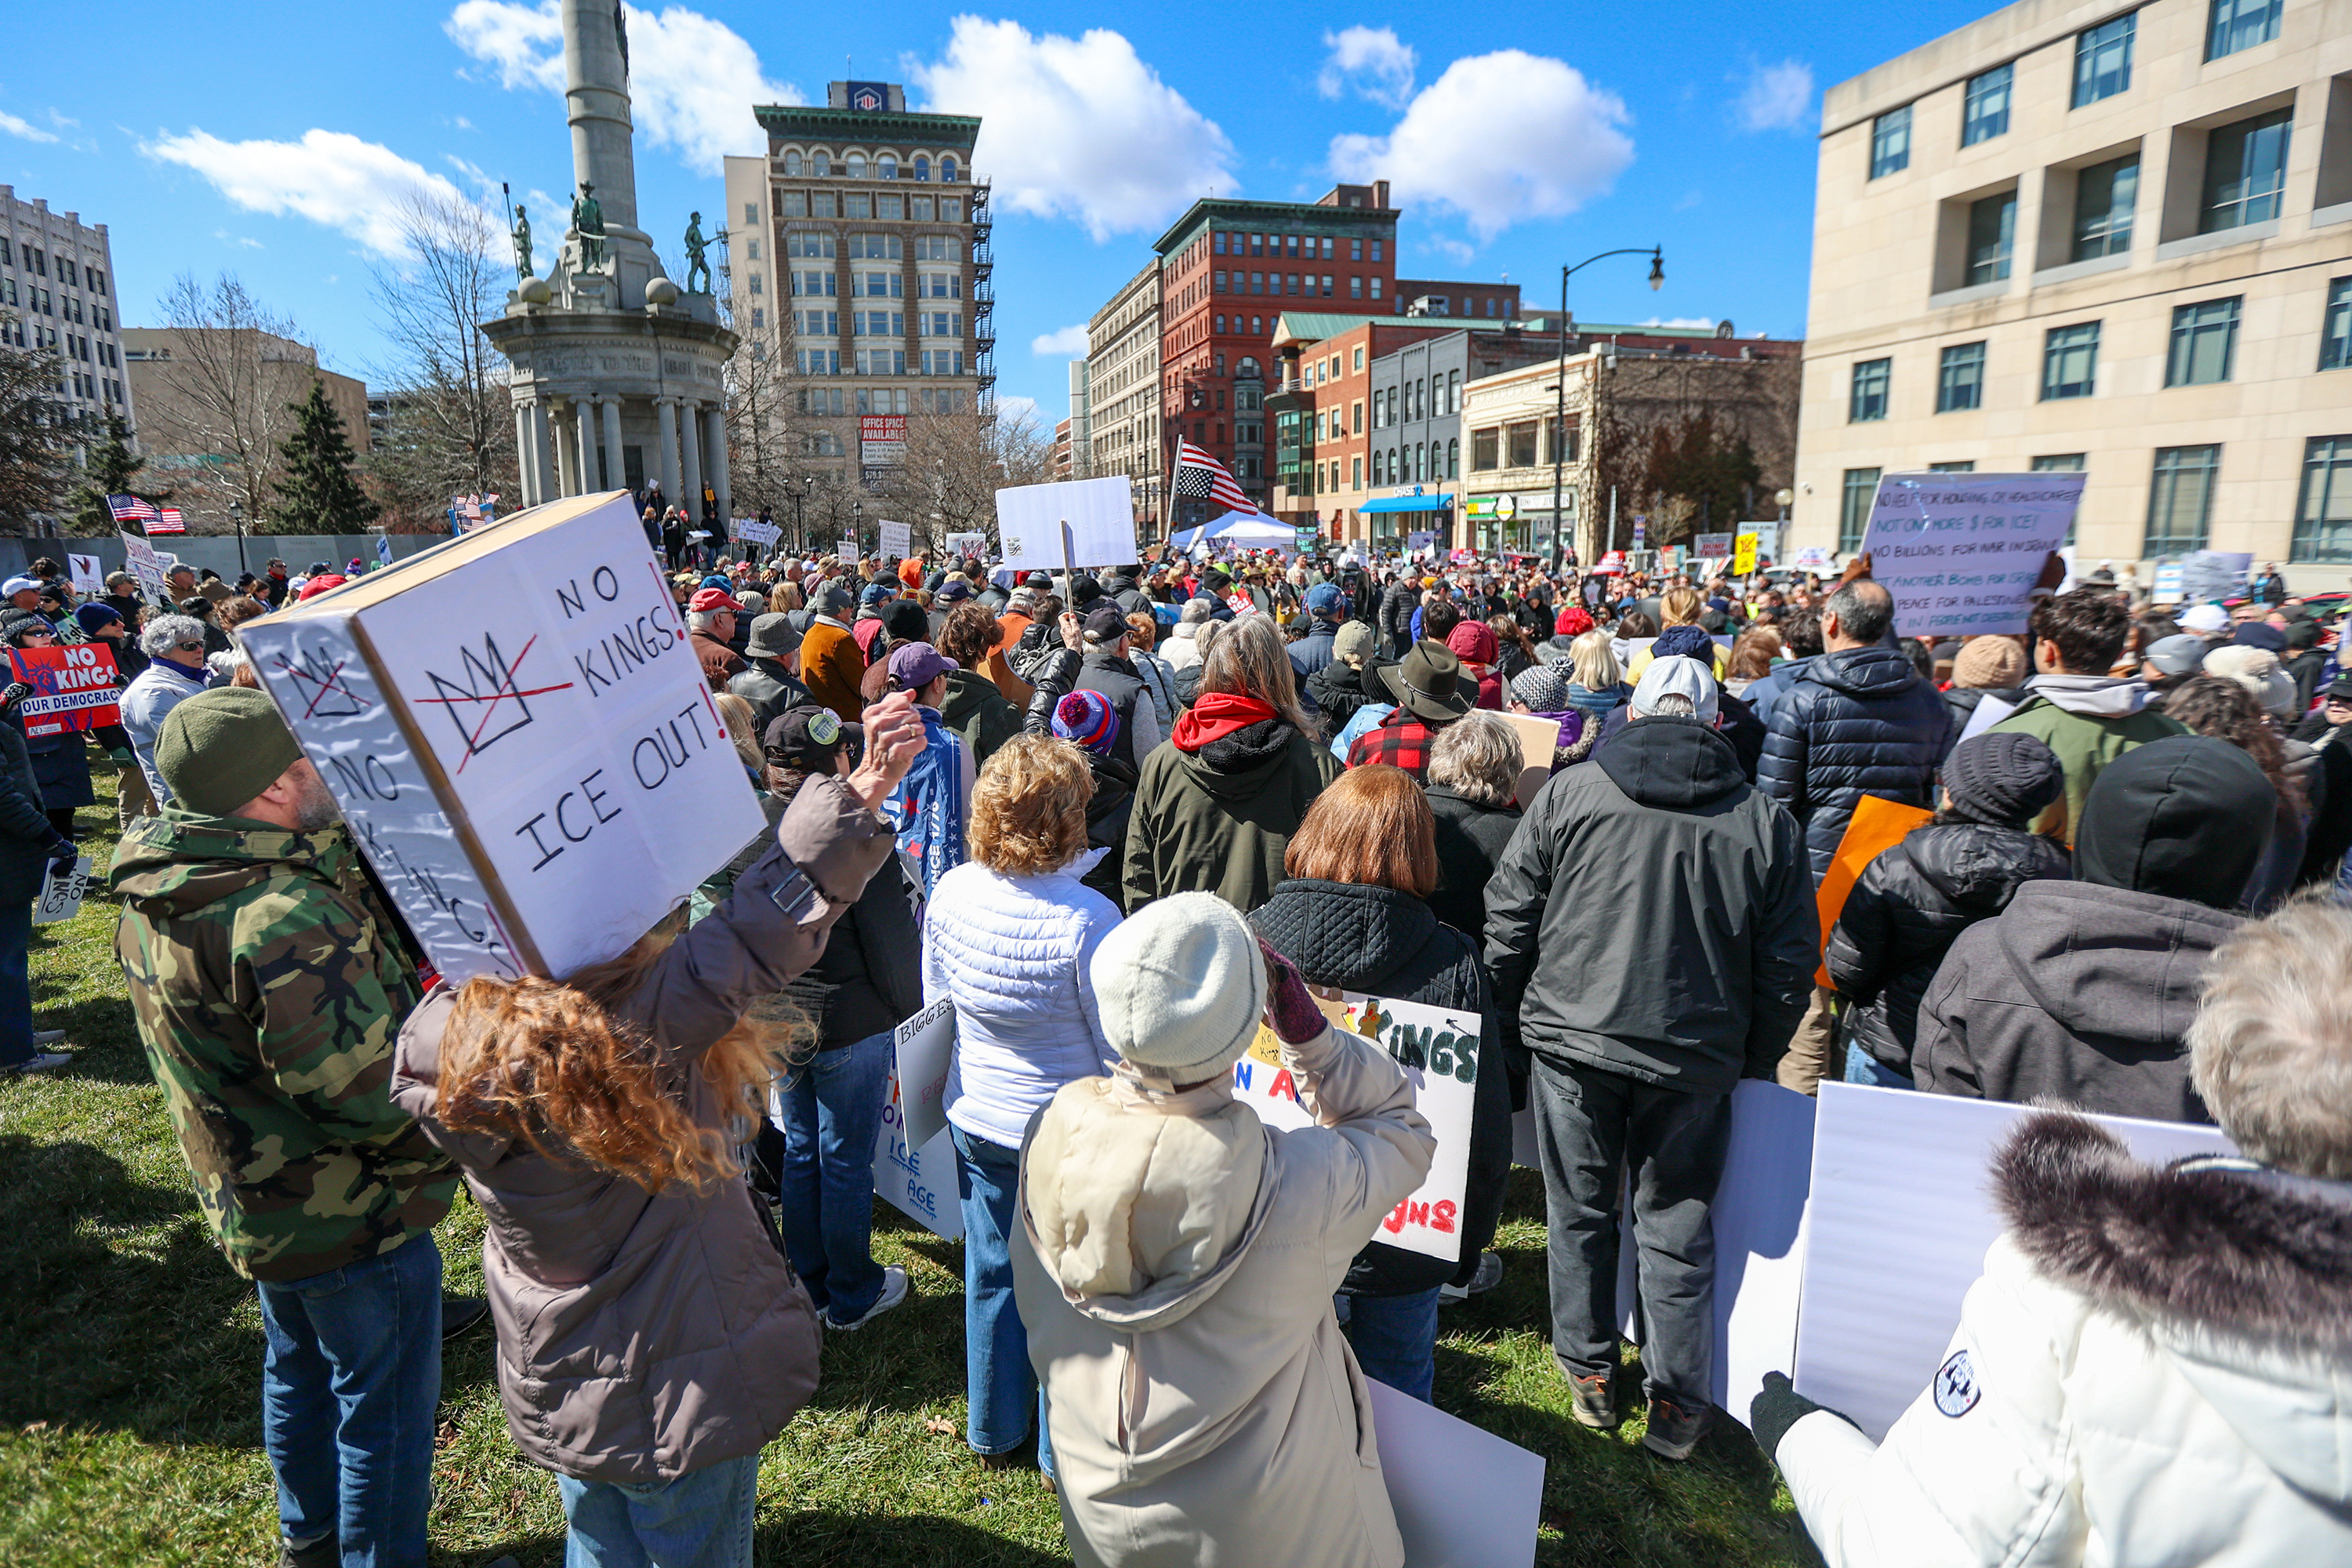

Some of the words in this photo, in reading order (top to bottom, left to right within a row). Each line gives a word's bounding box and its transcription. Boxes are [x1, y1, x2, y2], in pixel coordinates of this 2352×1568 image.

[626, 354, 652, 372] THE
[862, 417, 884, 428] OFFICE
[884, 417, 904, 428] SPACE
[863, 429, 905, 440] AVAILABLE
[1393, 485, 1415, 497] CHASE
[1466, 501, 1496, 515] SUBWAY
[1875, 517, 1905, 533] NOT
[1933, 517, 1965, 531] MORE
[1970, 514, 1979, 532] $
[1982, 515, 2005, 531] FOR
[1872, 545, 1890, 559] NO
[1894, 544, 1945, 558] BILLIONS
[1951, 543, 1976, 557] FOR
[1893, 574, 1944, 588] ANOTHER
[1985, 573, 2006, 585] FOR
[555, 564, 619, 619] NO
[1897, 597, 1930, 610] PEACE
[1936, 596, 1959, 609] FOR
[1908, 616, 1924, 628] IN
[64, 647, 96, 669] NO
[54, 664, 116, 691] KINGS
[23, 698, 53, 713] OUR
[328, 754, 399, 801] NO
[514, 768, 622, 873] ICE
[929, 844, 942, 889] INCE
[45, 867, 77, 914] INGS
[70, 873, 88, 901] NO
[899, 994, 955, 1045] BIGGES
[1261, 1031, 1272, 1047] NO
[1259, 1045, 1279, 1064] Kings
[888, 1134, 920, 1171] ICE
[906, 1178, 936, 1211] AGE
